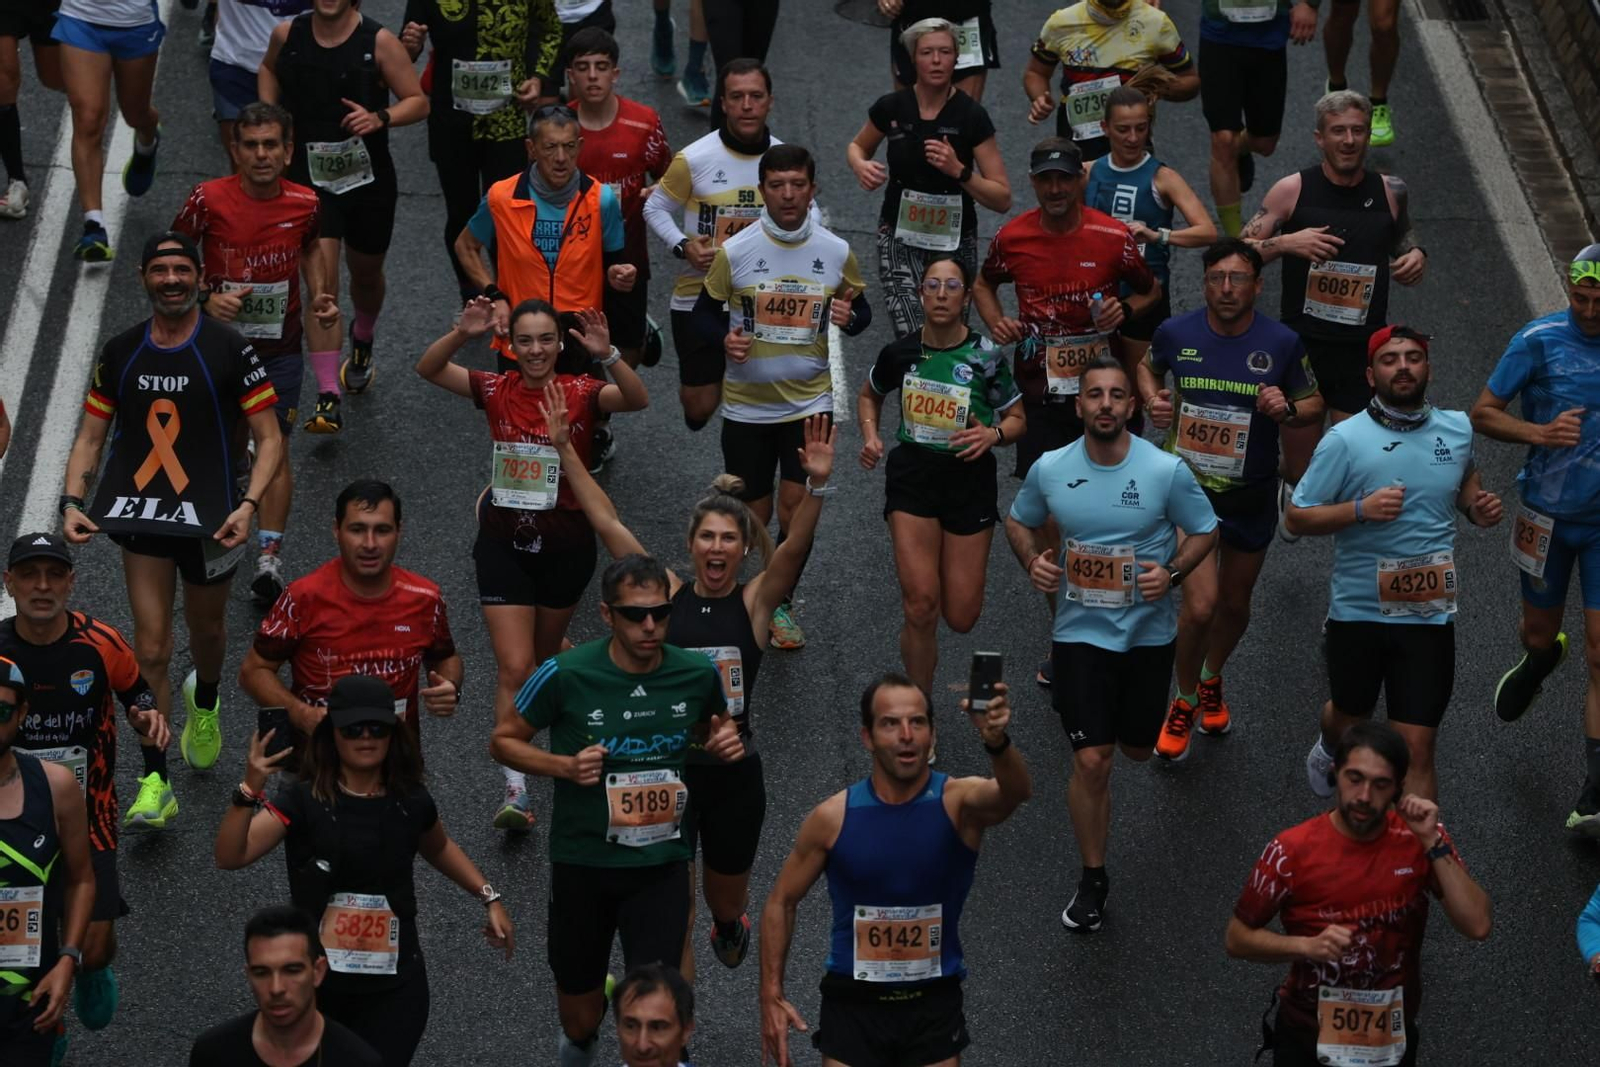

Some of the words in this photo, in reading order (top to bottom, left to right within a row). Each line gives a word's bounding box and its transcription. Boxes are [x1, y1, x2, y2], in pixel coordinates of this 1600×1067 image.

[461, 75, 499, 91] 9142
[317, 152, 354, 173] 7287
[739, 190, 756, 203] 59
[908, 205, 948, 226] 8112
[1317, 276, 1361, 298] 6087
[241, 299, 275, 315] 643
[765, 298, 809, 318] 4497
[138, 374, 190, 393] STOP
[906, 394, 958, 421] 12045
[1186, 421, 1231, 447] 4576
[1434, 448, 1451, 457] CGR
[1434, 456, 1453, 464] TEAM
[502, 458, 543, 481] 7929
[1120, 499, 1140, 507] TEAM
[1121, 491, 1140, 500] CGR
[103, 496, 203, 527] ELA
[1072, 559, 1115, 581] 4321
[1389, 571, 1439, 595] 4320
[633, 709, 657, 719] ZURICH
[621, 789, 670, 815] 5189
[334, 912, 387, 940] 5825
[868, 925, 923, 949] 6142
[1332, 1007, 1388, 1034] 5074
